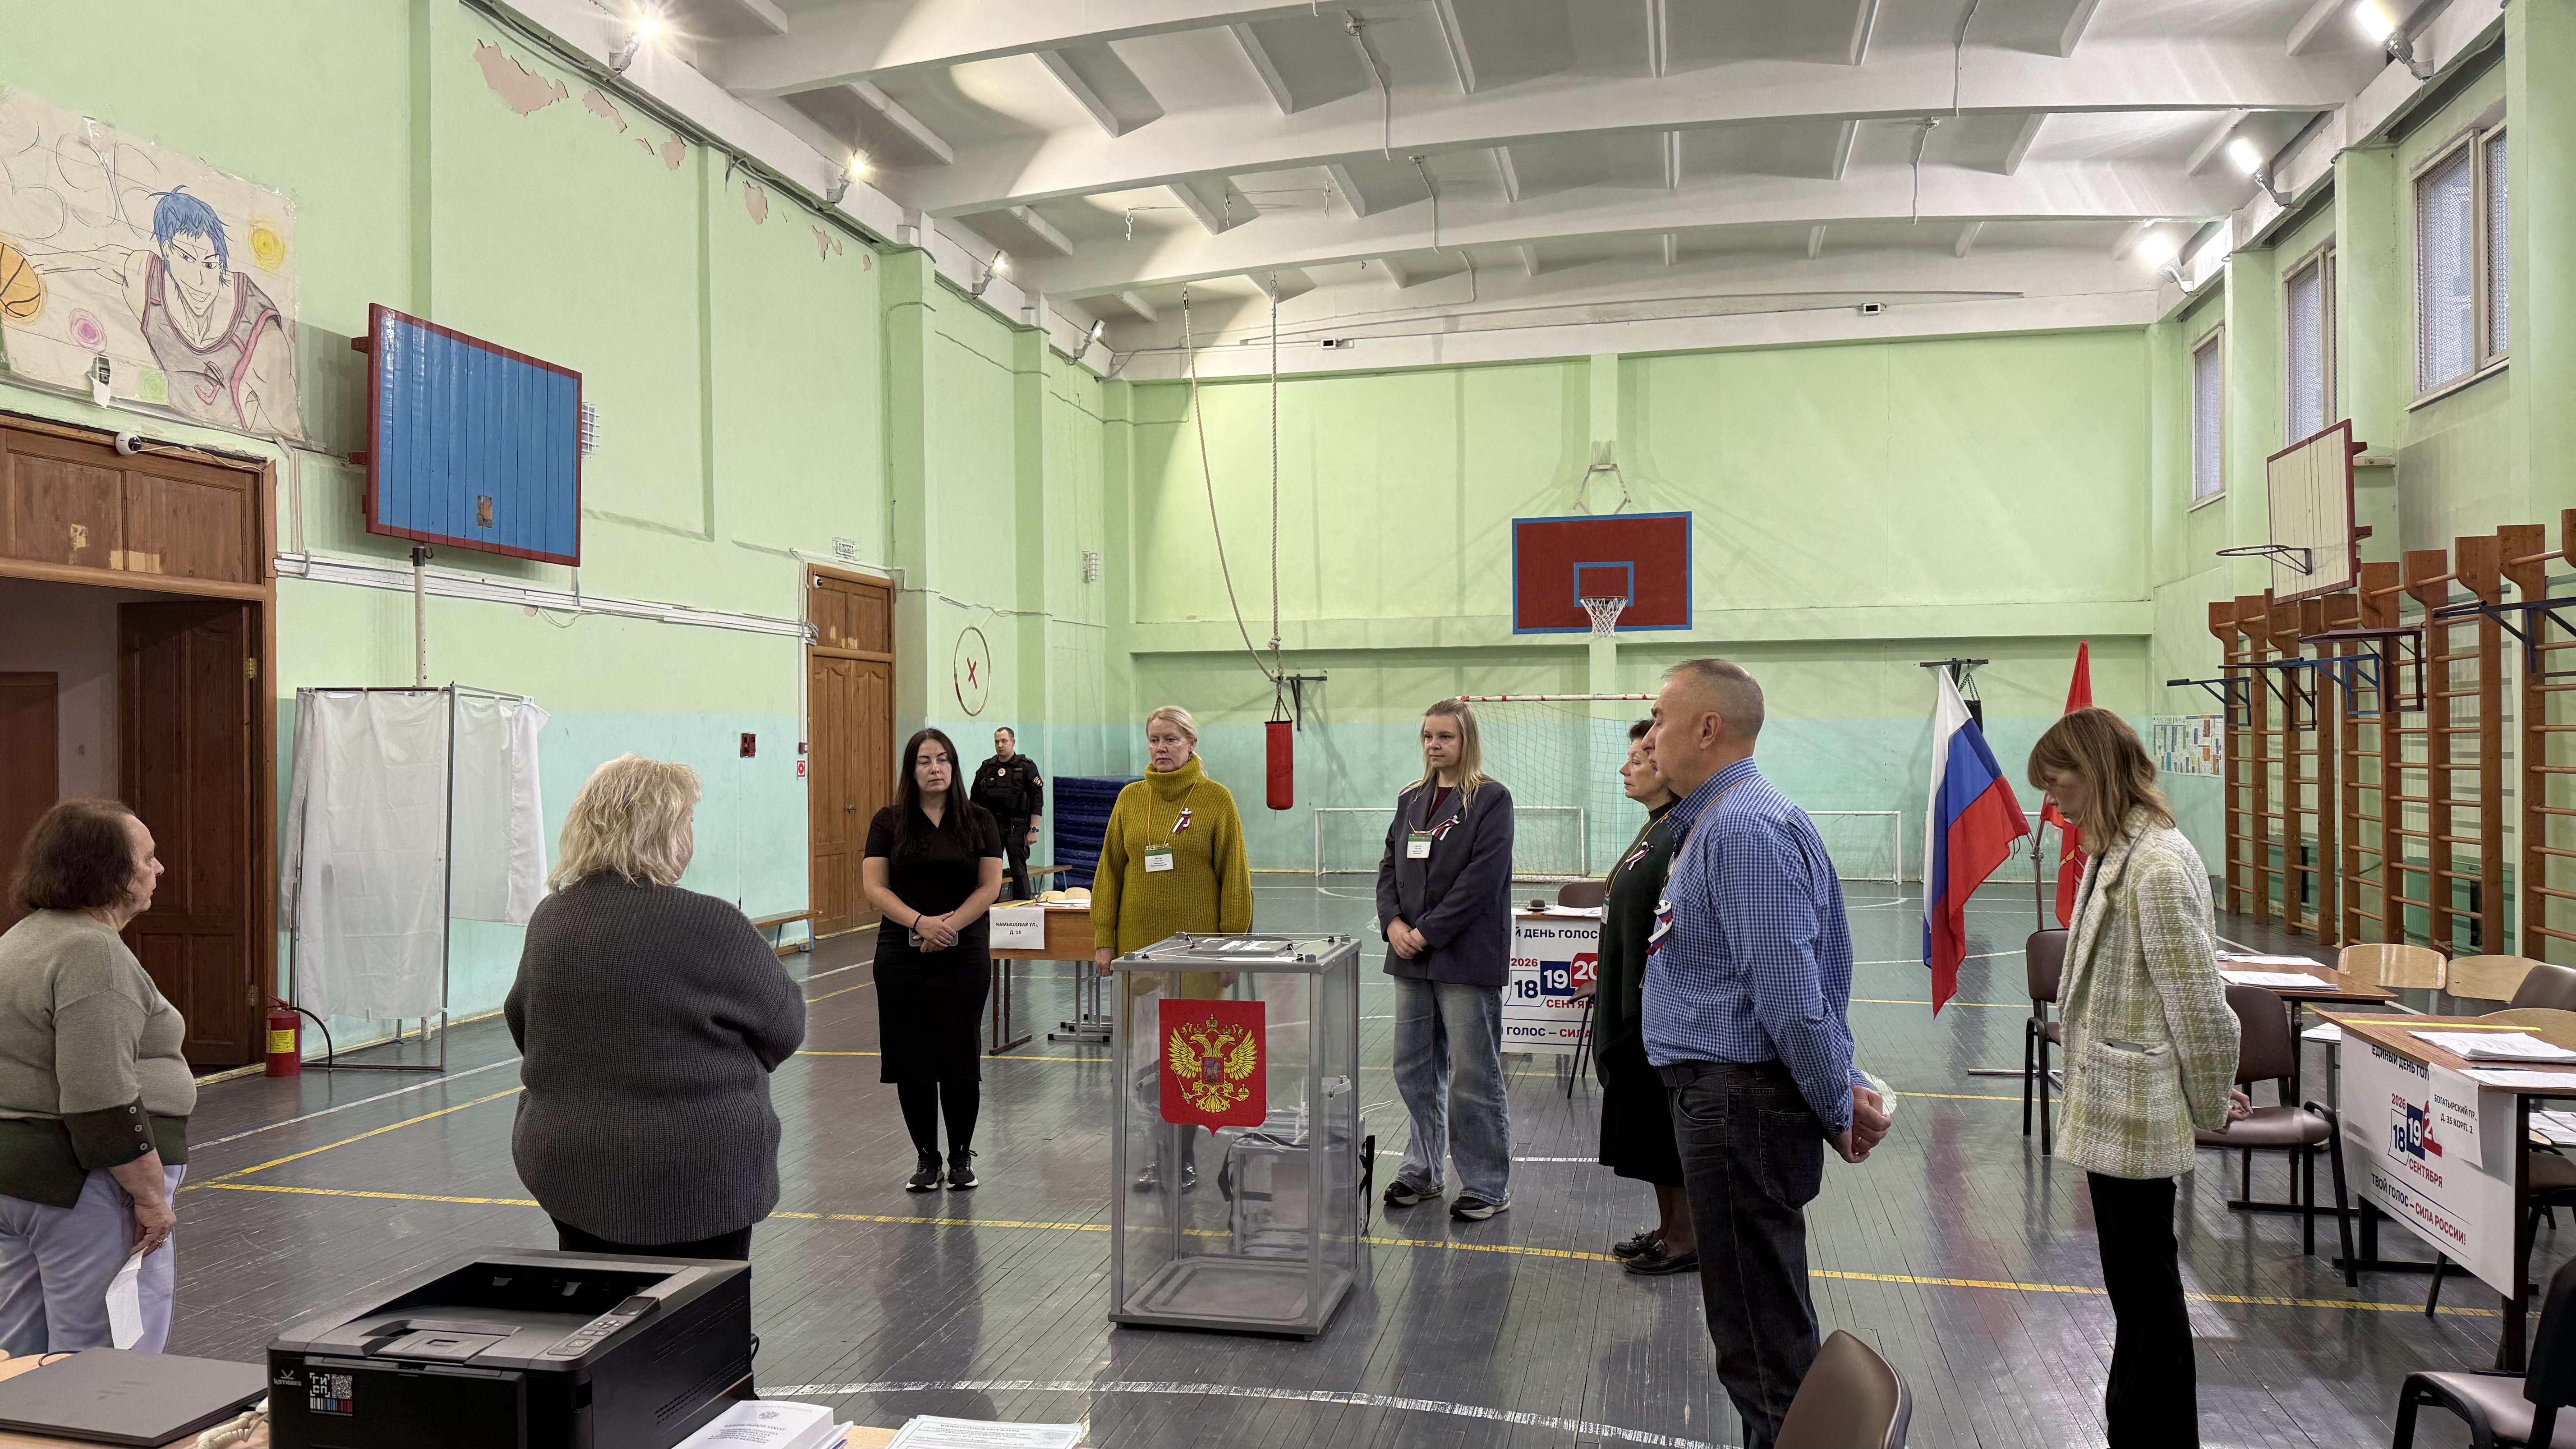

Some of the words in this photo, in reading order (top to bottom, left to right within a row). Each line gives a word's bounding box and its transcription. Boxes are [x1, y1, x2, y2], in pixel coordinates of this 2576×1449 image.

[1524, 929, 1555, 938] ДЕНЬ
[1559, 929, 1598, 939] ГОЛОС
[1511, 958, 1538, 967] 2026
[1514, 980, 1538, 999] 18
[1544, 970, 1569, 989] 19
[1507, 1026, 1546, 1036] ГОЛОС
[2372, 1044, 2398, 1066] ЕДИНЫЙ
[2399, 1056, 2415, 1073] ДЕНЬ
[2417, 1064, 2429, 1081] ГОЛ
[2392, 1093, 2406, 1110] 2026
[2434, 1094, 2468, 1116] БОГАТЫРСКИЙ
[2408, 1117, 2422, 1147] 19
[2424, 1112, 2432, 1141] 2
[2447, 1116, 2452, 1124] 35
[2453, 1118, 2469, 1132] КОРП.
[2470, 1126, 2473, 1134] 2
[2393, 1124, 2406, 1153] 18
[2409, 1158, 2443, 1188] СЕНТЯБРЯ
[2371, 1173, 2387, 1193] ТВОЙ
[2388, 1184, 2409, 1207] ГОЛОС
[2415, 1202, 2433, 1224] СИЛА
[2435, 1214, 2466, 1246] РОССИИ!
